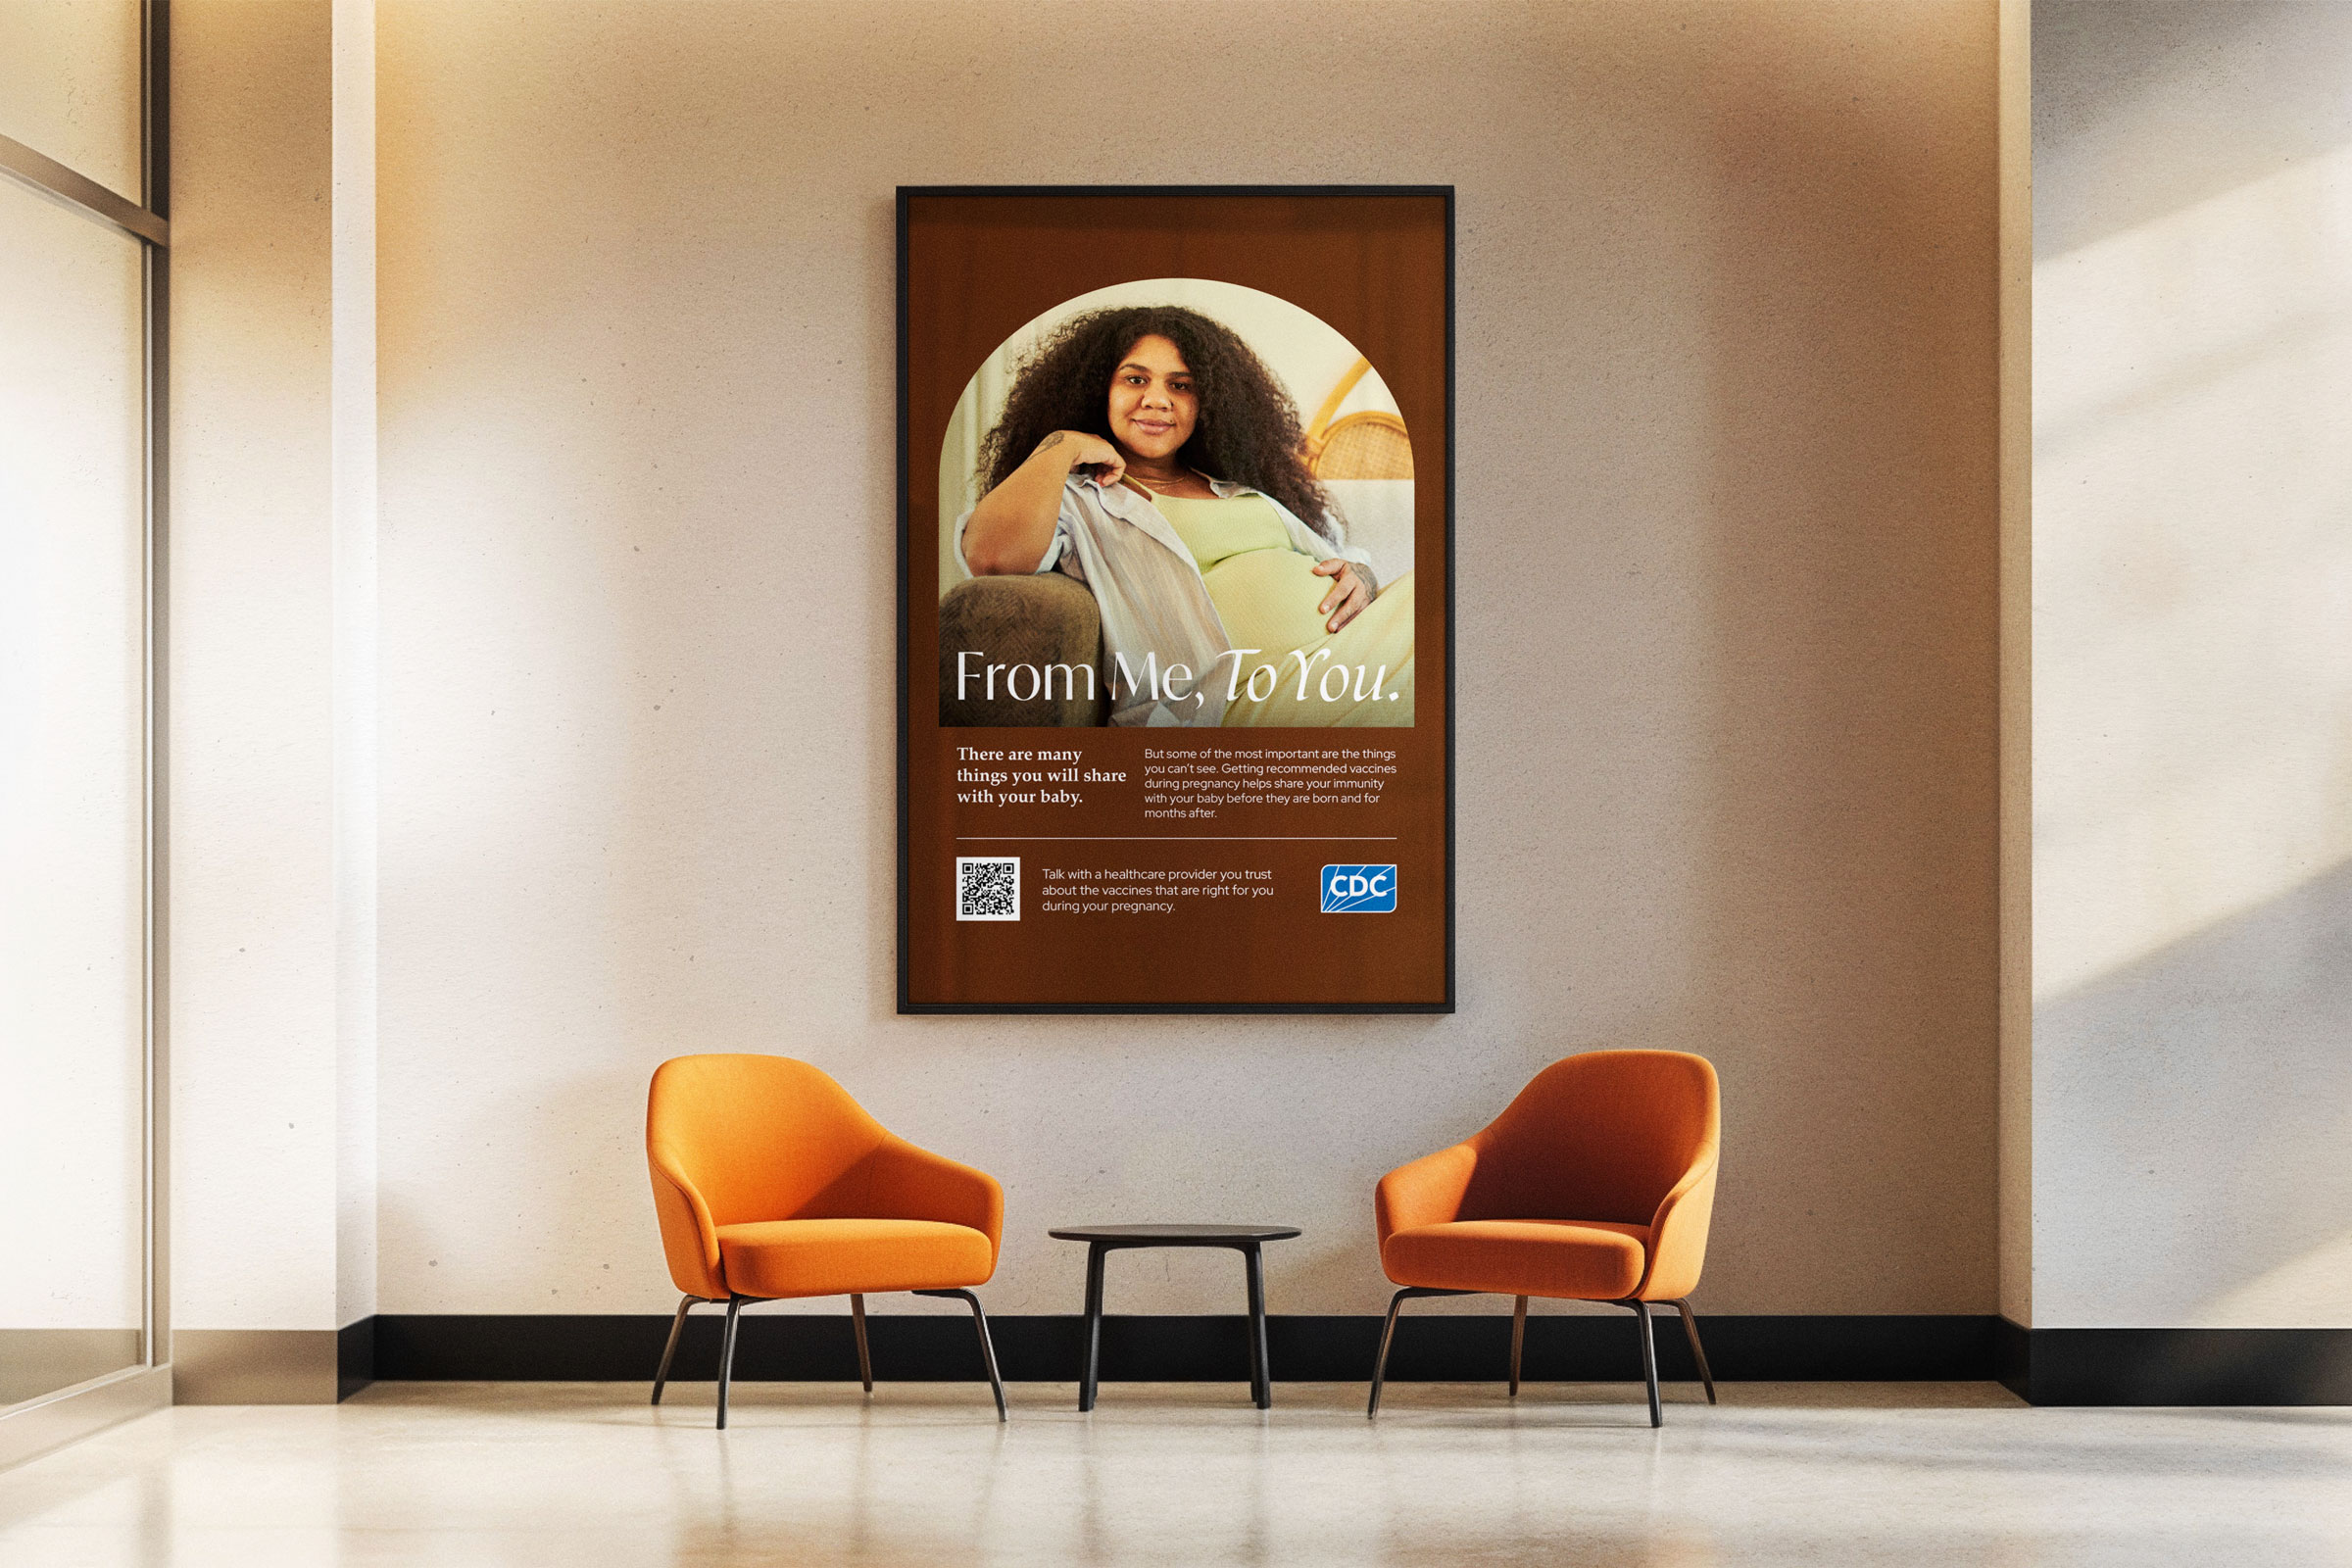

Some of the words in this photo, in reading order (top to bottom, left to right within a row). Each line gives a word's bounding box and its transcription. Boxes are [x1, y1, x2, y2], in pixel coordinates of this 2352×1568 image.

[956, 651, 1096, 702] From
[1111, 651, 1204, 710] Me,
[1215, 648, 1276, 703] To
[1289, 648, 1400, 703] You.
[956, 746, 1004, 761] There
[1007, 750, 1033, 761] are
[1037, 750, 1083, 765] many
[1145, 748, 1165, 760] But
[1165, 751, 1198, 760] some
[1199, 747, 1212, 760] of
[1213, 748, 1233, 760] the
[1234, 749, 1263, 760] most
[1264, 748, 1320, 761] important
[1321, 750, 1340, 760] are
[1341, 748, 1361, 760] the
[1361, 748, 1396, 761] things
[1144, 765, 1165, 776] you
[1196, 765, 1219, 774] see.
[1221, 762, 1264, 776] Getting
[1266, 762, 1348, 774] recommended
[1348, 762, 1397, 774] vaccines
[956, 767, 1008, 787] things
[1011, 771, 1043, 787] you
[1047, 767, 1079, 782] will
[1083, 767, 1127, 783] share
[1144, 778, 1180, 792] during
[1182, 780, 1241, 792] pregnancy
[1242, 778, 1273, 791] helps
[1273, 778, 1304, 789] share
[1305, 780, 1332, 792] your
[1333, 778, 1385, 792] immunity
[956, 788, 995, 804] with
[998, 792, 1037, 808] your
[1040, 788, 1083, 808] baby.
[1144, 793, 1168, 804] with
[1169, 795, 1195, 807] your
[1197, 793, 1225, 807] baby
[1226, 792, 1264, 804] before
[1265, 793, 1291, 807] they
[1292, 795, 1310, 804] are
[1312, 793, 1339, 804] born
[1340, 793, 1362, 804] and
[1363, 792, 1381, 804] for
[1144, 808, 1187, 818] months
[1188, 807, 1217, 818] after.
[1042, 868, 1065, 880] Talk
[1067, 868, 1093, 880] with
[1094, 870, 1102, 880] a
[1103, 868, 1166, 880] healthcare
[1168, 868, 1218, 882] provider
[1219, 870, 1243, 883] you
[1245, 869, 1272, 880] trust
[1042, 884, 1077, 896] about
[1079, 884, 1100, 896] the
[1102, 884, 1153, 896] vaccines
[1154, 884, 1179, 896] that
[1180, 886, 1200, 896] are
[1201, 884, 1230, 899] right
[1231, 883, 1250, 896] for
[1251, 887, 1274, 899] you
[1331, 875, 1388, 897] CDC
[1042, 900, 1080, 914] during
[1082, 903, 1109, 914] your
[1111, 903, 1176, 914] pregnancy.
